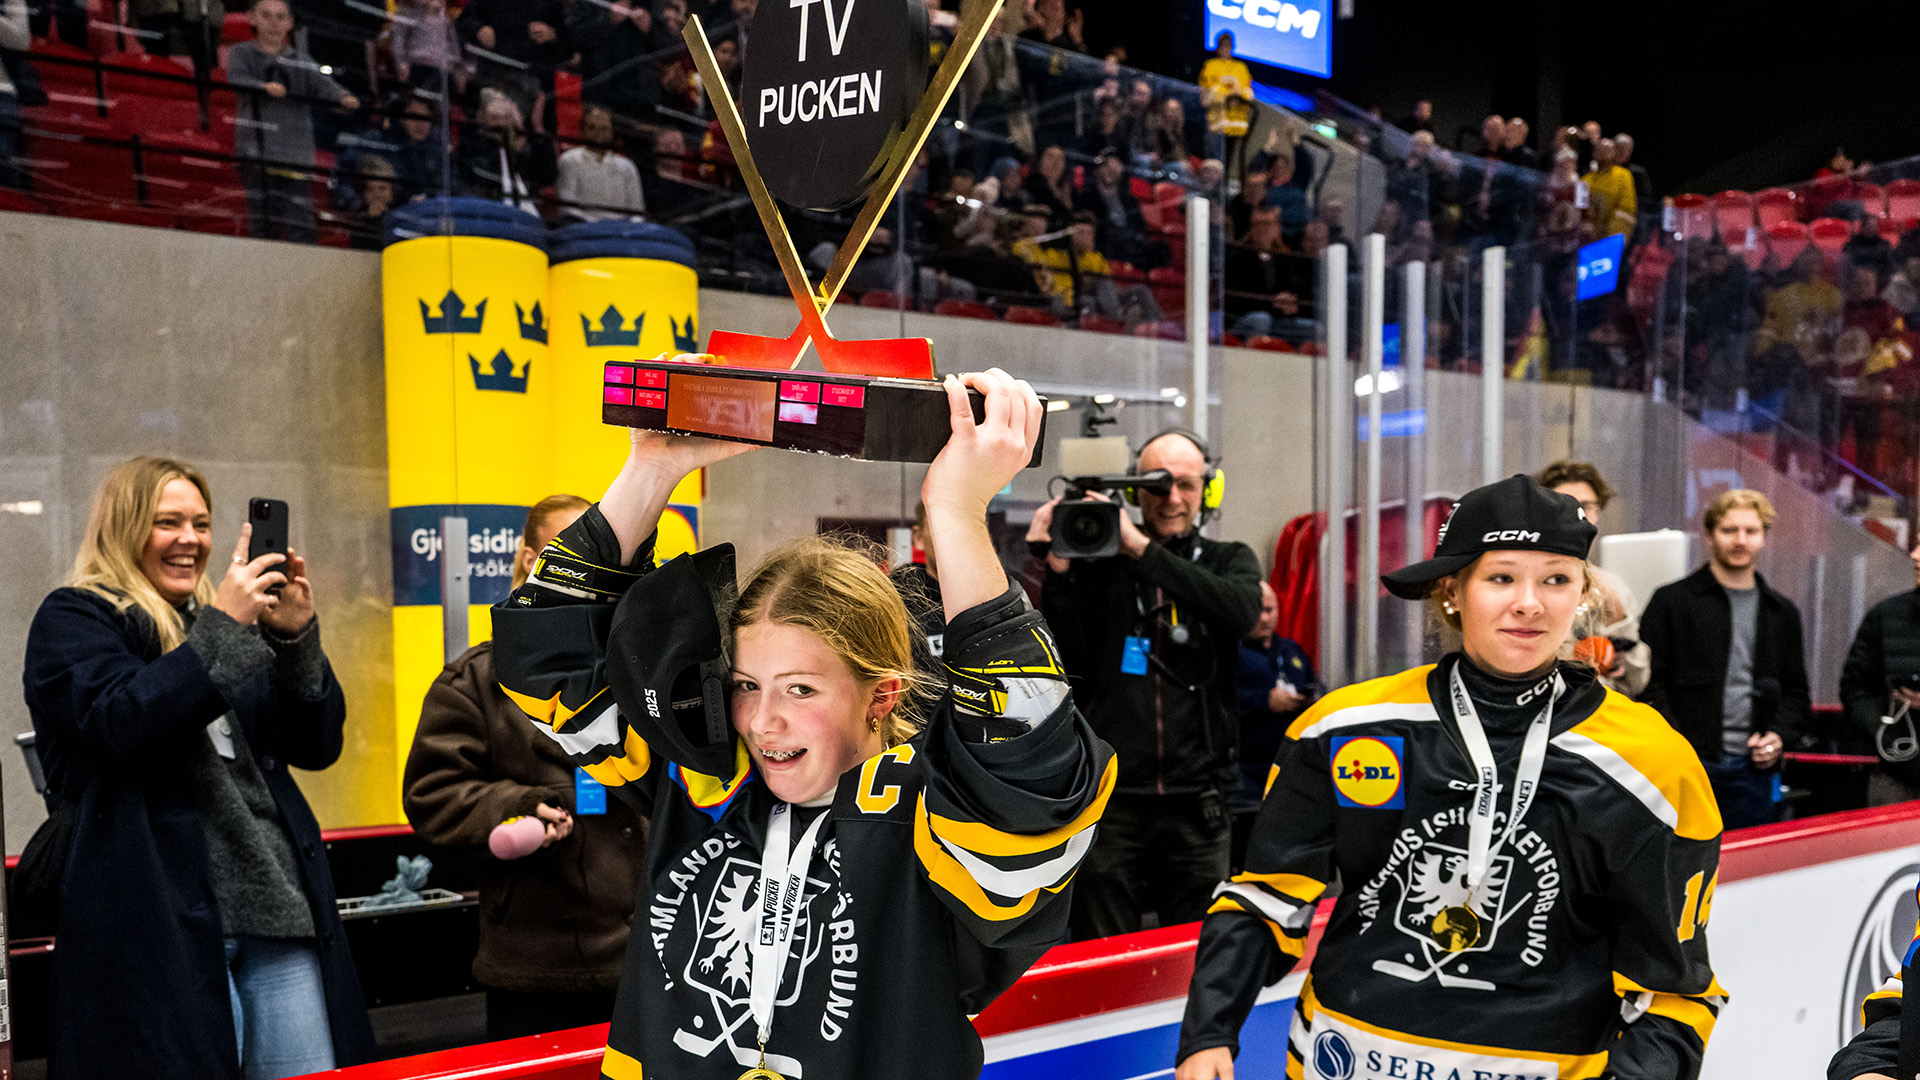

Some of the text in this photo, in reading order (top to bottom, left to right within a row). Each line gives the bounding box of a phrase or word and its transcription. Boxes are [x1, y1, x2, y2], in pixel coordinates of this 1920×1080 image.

[790, 0, 856, 62] TV
[1206, 0, 1321, 39] CCM
[759, 69, 882, 128] PUCKEN
[411, 527, 523, 561] Gjsidi
[1482, 530, 1541, 543] CCM
[644, 688, 661, 718] 2025
[855, 743, 916, 814] C
[766, 878, 780, 911] PUCKEN
